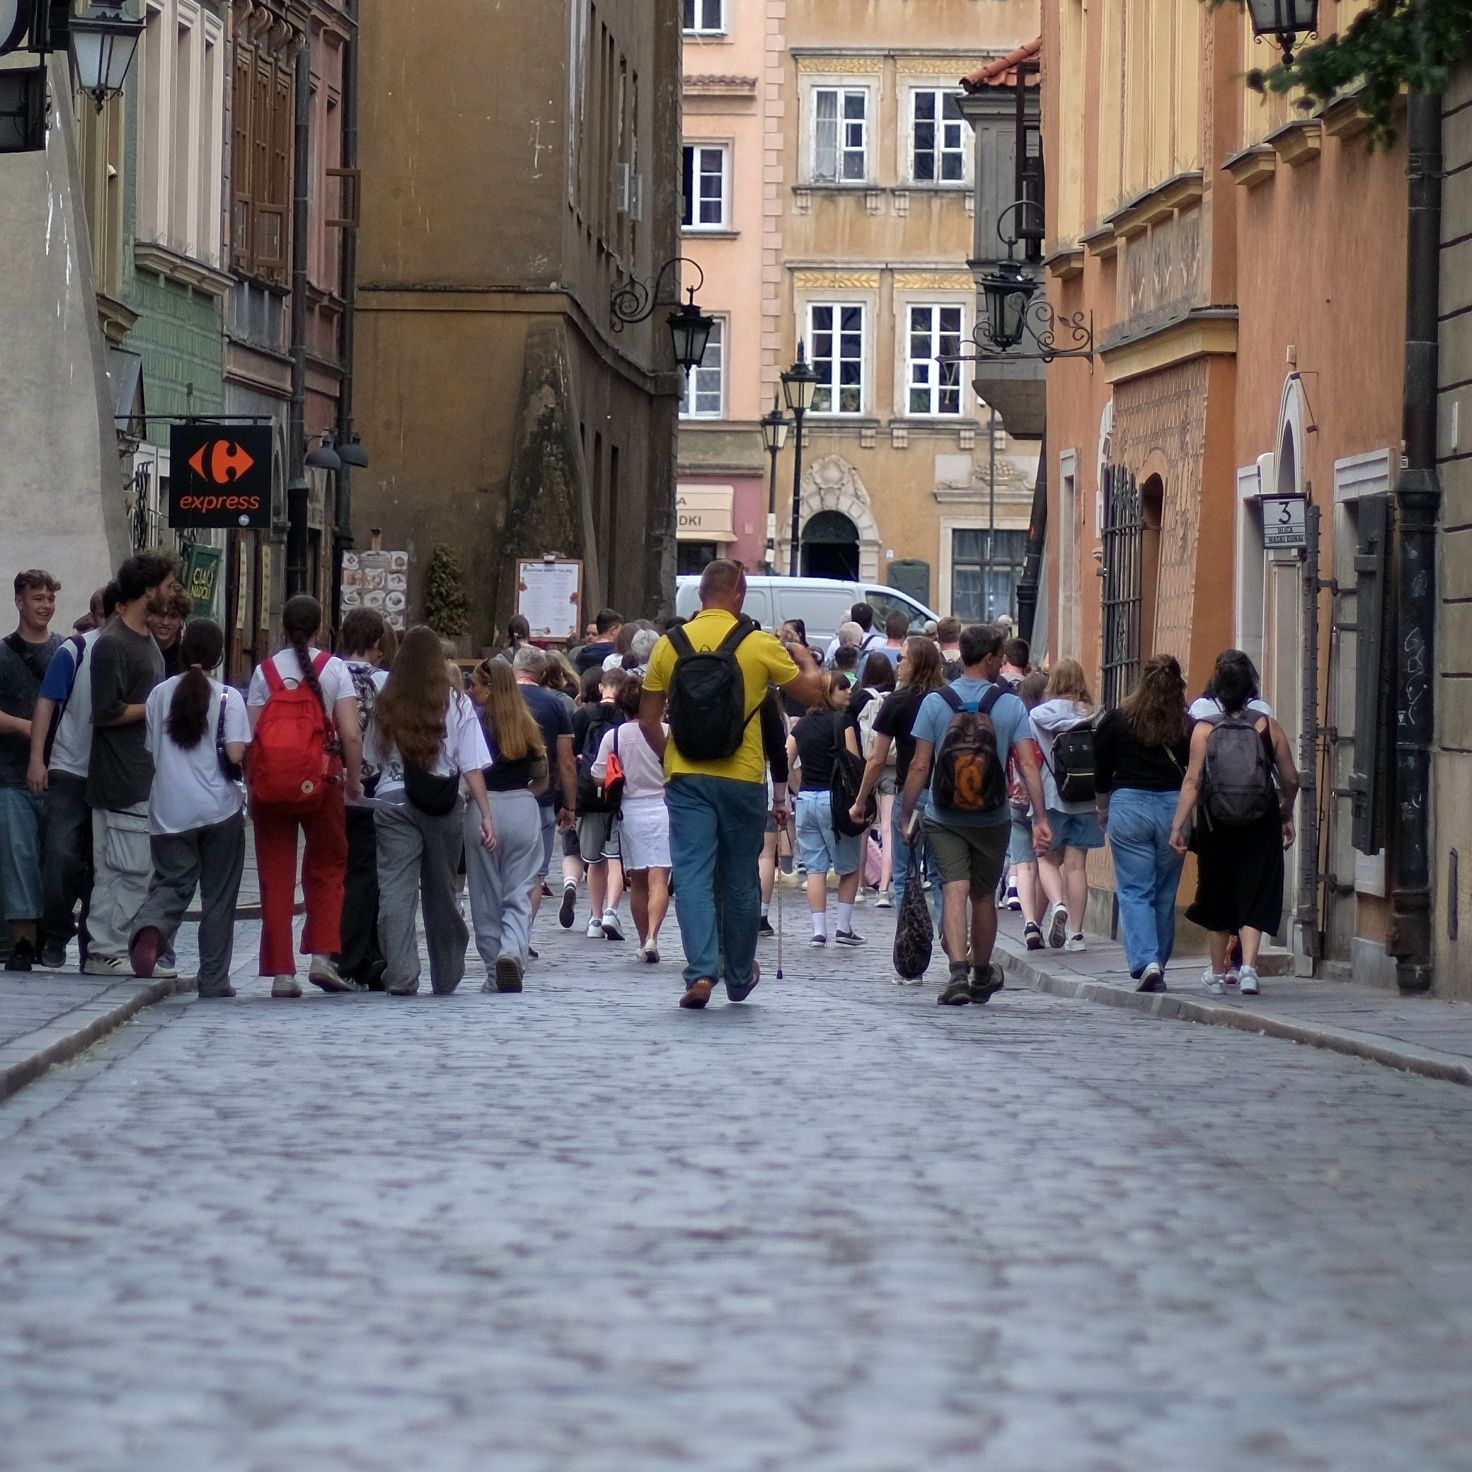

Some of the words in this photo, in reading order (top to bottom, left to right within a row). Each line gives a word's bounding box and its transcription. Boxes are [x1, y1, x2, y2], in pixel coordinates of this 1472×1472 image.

[179, 494, 261, 514] express
[1278, 501, 1292, 525] 3
[679, 515, 702, 526] DKI
